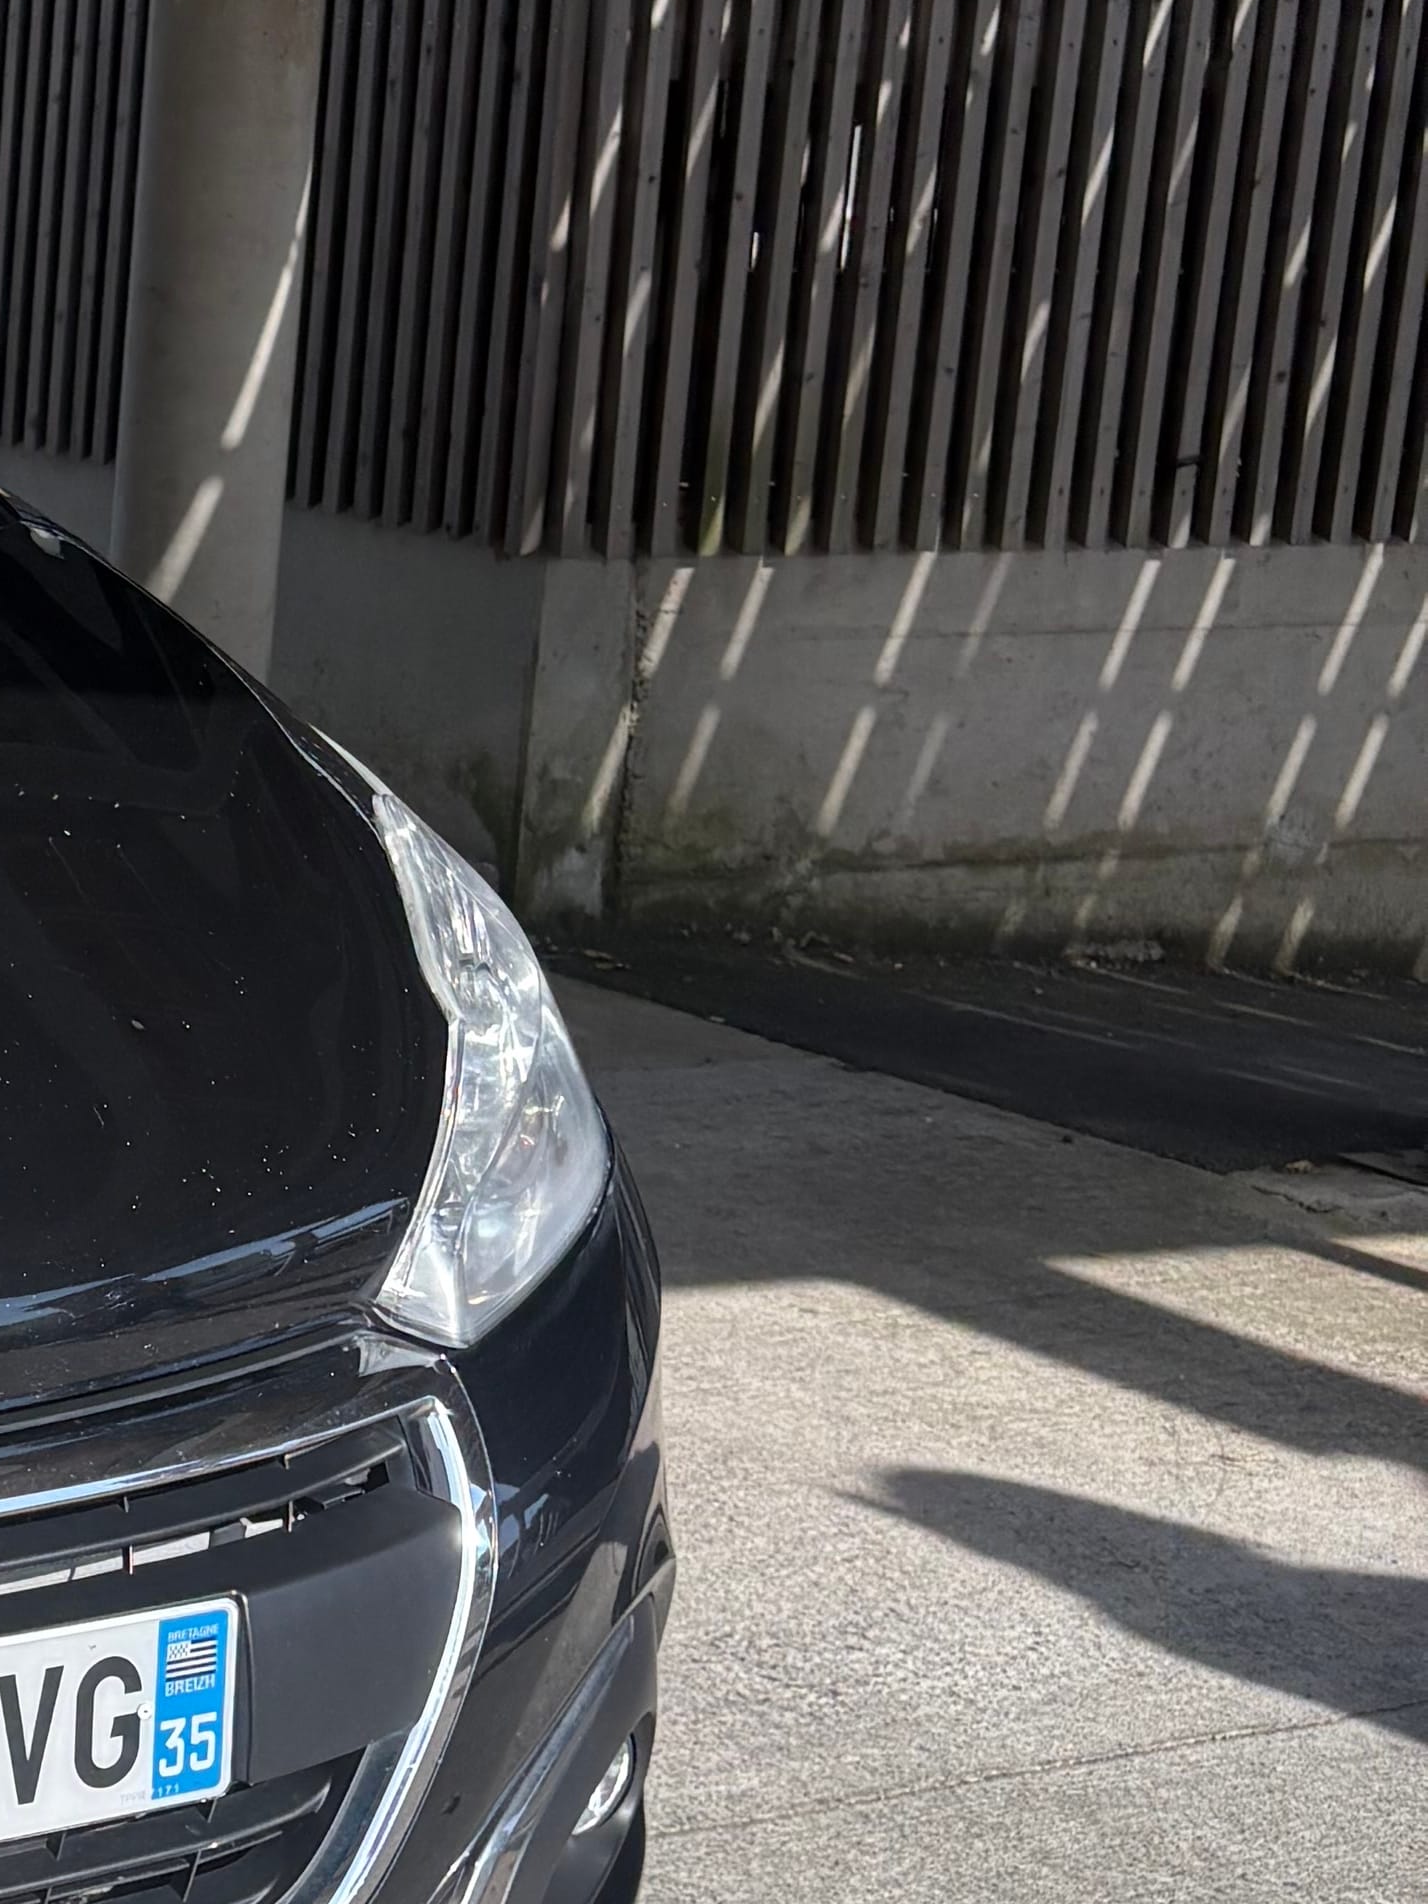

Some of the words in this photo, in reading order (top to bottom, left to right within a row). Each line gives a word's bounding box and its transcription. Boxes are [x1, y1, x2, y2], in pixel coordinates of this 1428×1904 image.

[168, 1624, 219, 1642] BRETAGNE
[165, 1673, 215, 1697] BREIZH
[158, 1712, 217, 1778] 35
